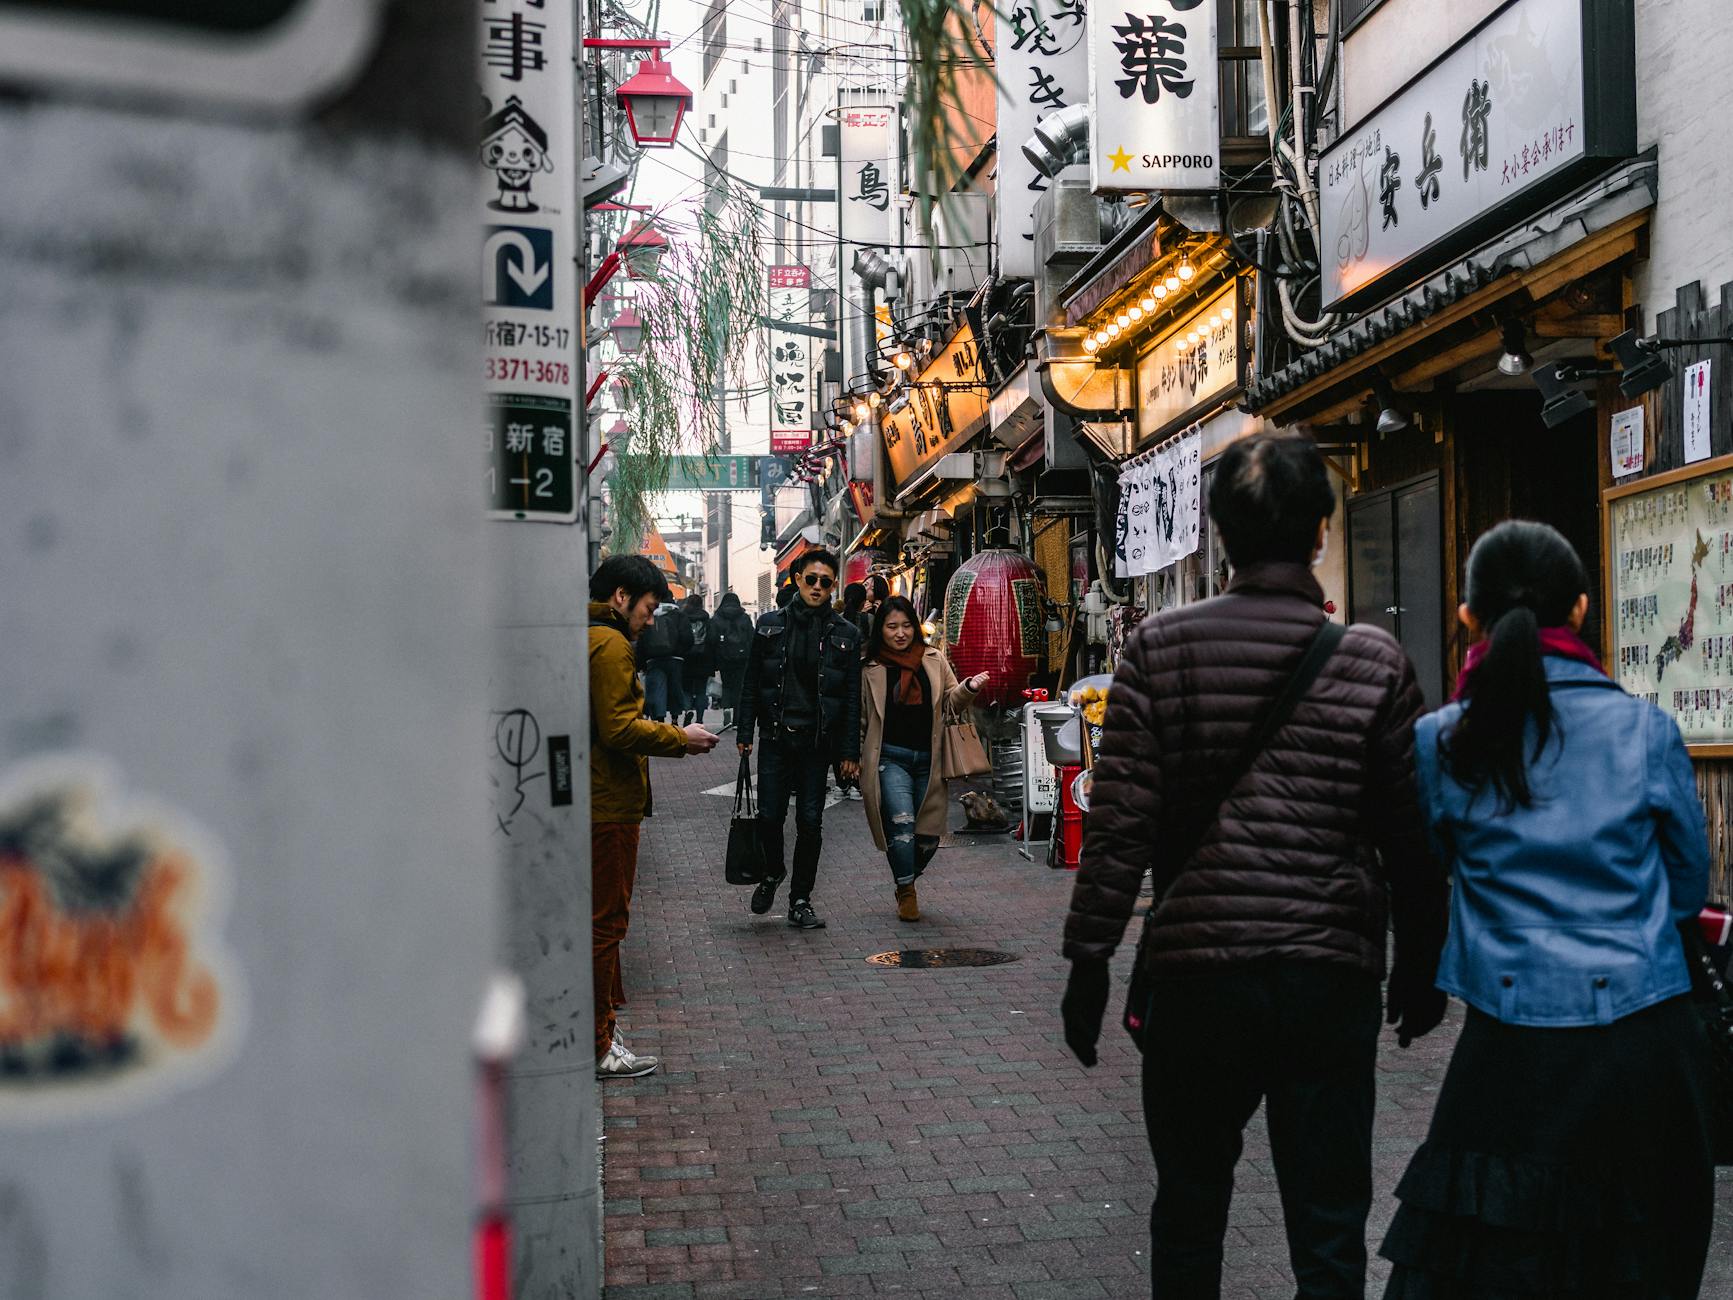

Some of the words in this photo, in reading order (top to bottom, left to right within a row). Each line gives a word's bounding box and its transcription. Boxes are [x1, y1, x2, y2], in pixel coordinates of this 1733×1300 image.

[481, 0, 548, 82] 事
[1111, 0, 1203, 104] 葉
[848, 161, 889, 212] 鳥
[1142, 154, 1213, 169] SAPPORO
[1379, 78, 1491, 233] 安兵衛
[1501, 116, 1575, 186] 大小宴会承ります
